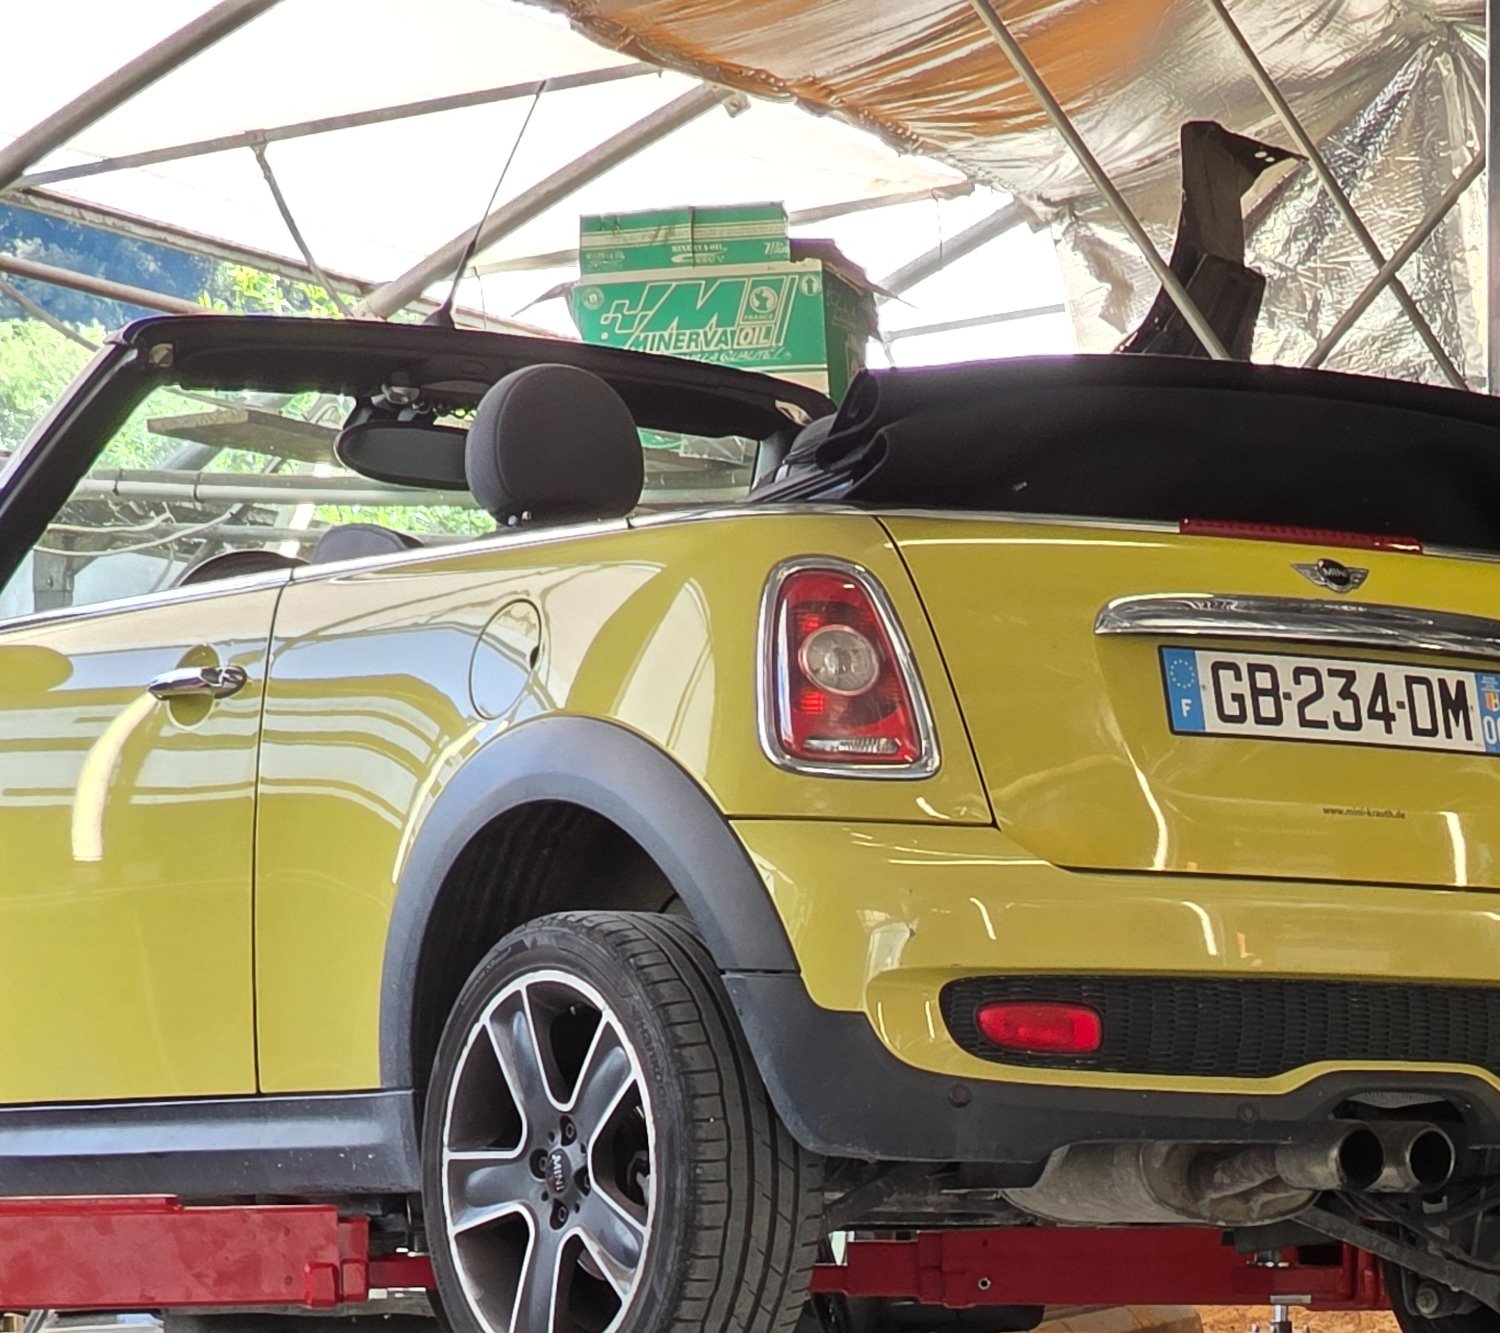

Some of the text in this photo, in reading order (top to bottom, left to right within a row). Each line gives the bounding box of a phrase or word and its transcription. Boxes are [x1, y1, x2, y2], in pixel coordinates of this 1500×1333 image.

[635, 327, 771, 351] MINERVA OIL
[1181, 698, 1192, 718] F
[1210, 660, 1474, 741] GB-234-DM
[551, 1154, 565, 1191] MINI
